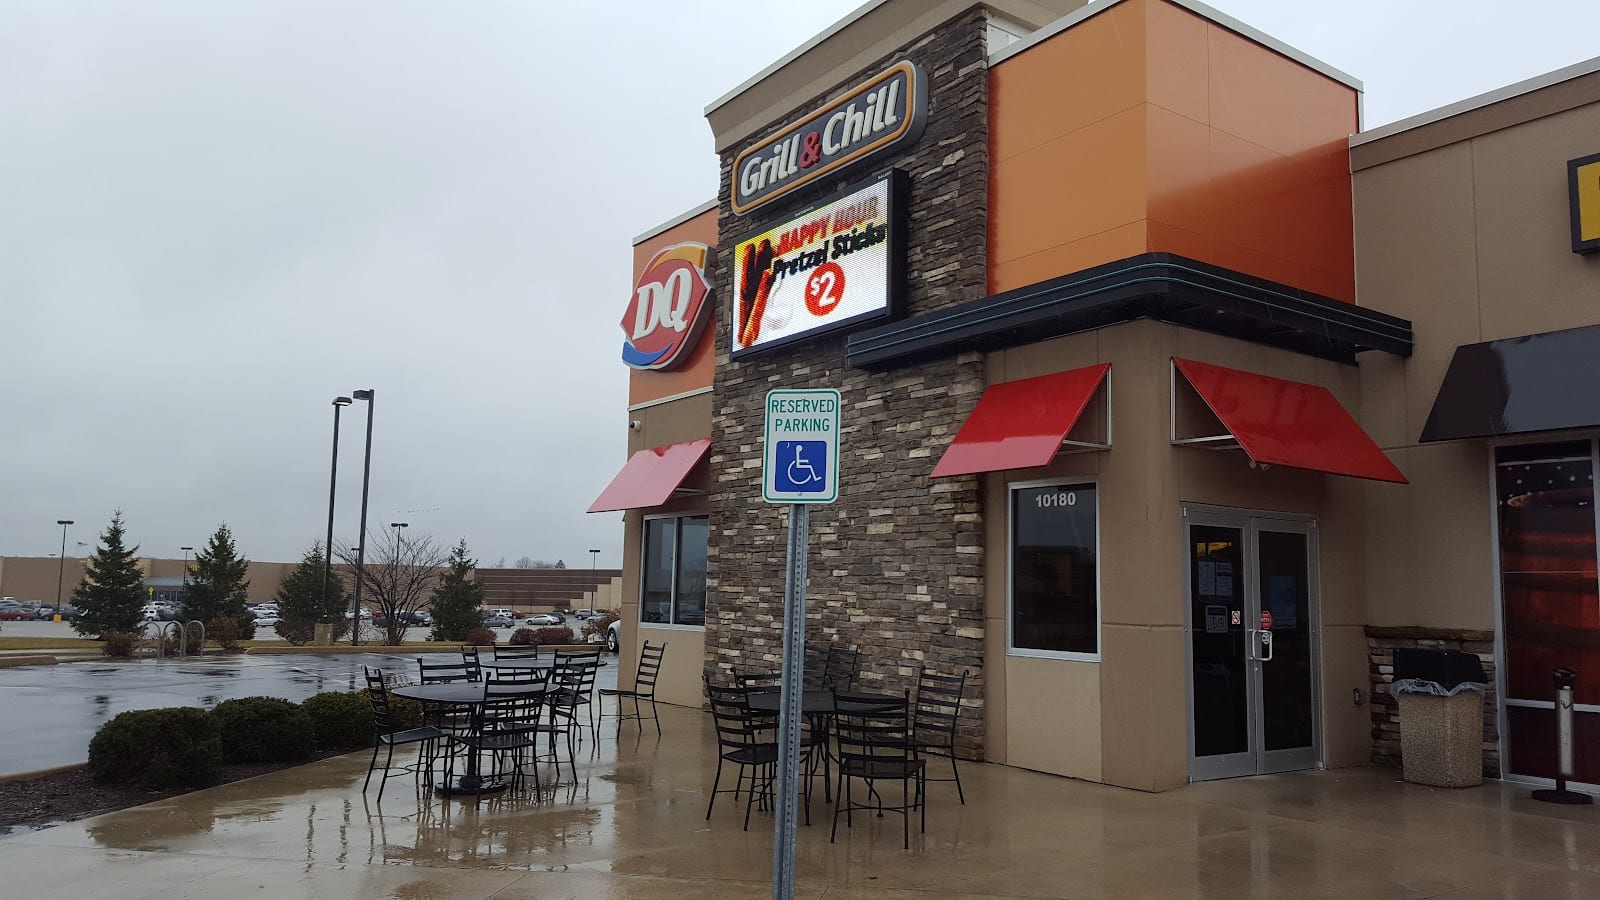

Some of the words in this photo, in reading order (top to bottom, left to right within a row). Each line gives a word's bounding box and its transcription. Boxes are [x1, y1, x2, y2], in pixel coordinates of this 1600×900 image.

[776, 213, 831, 256] HAPPY
[833, 196, 878, 234] HOUR
[773, 240, 830, 280] Pretzel
[831, 222, 887, 260] Sticks
[632, 267, 693, 341] DQ
[810, 274, 836, 307] $2
[771, 399, 835, 413] RESERVED
[775, 418, 830, 432] PARKING
[1035, 492, 1076, 508] 10180
